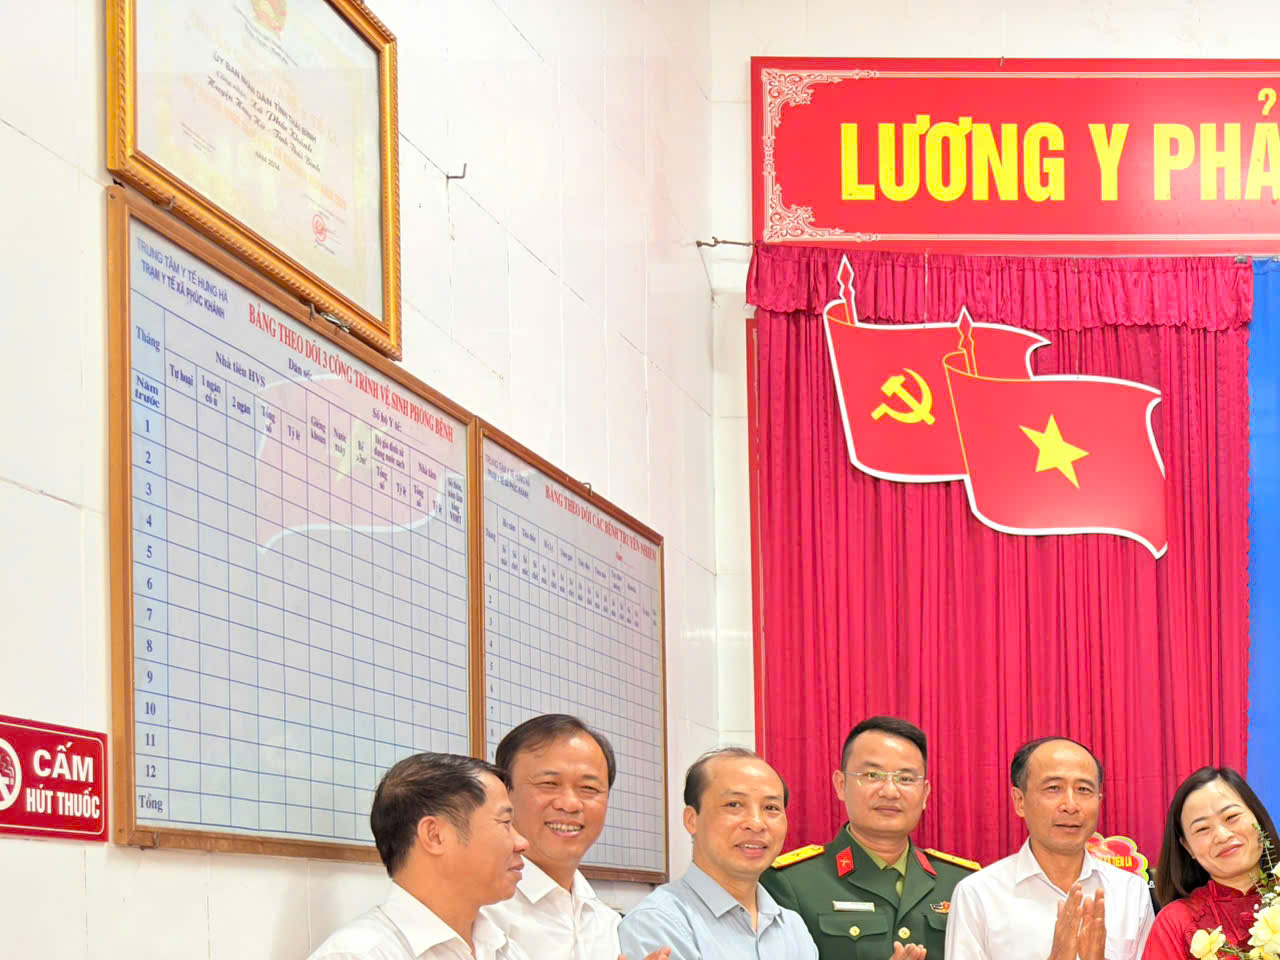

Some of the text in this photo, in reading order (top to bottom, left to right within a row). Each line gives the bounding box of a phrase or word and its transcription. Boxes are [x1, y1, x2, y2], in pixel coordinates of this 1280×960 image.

[841, 115, 1065, 201] LƯƠNG
[1088, 124, 1129, 200] Y
[136, 236, 163, 264] TRUNG
[165, 255, 180, 274] TÂM
[181, 265, 186, 278] Y
[187, 270, 197, 285] TẾ
[219, 288, 228, 303] HÀ
[161, 272, 166, 285] Y
[167, 275, 176, 291] TẾ
[186, 287, 203, 307] PHÚC
[136, 325, 160, 353] Tháng
[248, 368, 266, 388] HVS
[249, 302, 453, 443] BẢNG THEO DÕI 3 CÔNG TRÌNH VỆ SINH PHÒNG BỆNH
[136, 375, 159, 396] Năm
[135, 388, 160, 409] trước
[145, 419, 150, 433] 1
[145, 451, 152, 464] 2
[145, 482, 152, 496] 3
[146, 514, 153, 528] 4
[146, 545, 153, 559] 5
[146, 577, 153, 591] 6
[146, 608, 153, 622] 7
[146, 639, 153, 653] 8
[146, 670, 153, 685] 9
[145, 701, 156, 716] 10
[145, 733, 156, 747] 11
[33, 741, 94, 783] CẤM
[146, 764, 157, 779] 12
[26, 783, 100, 819] HÚT THUỐC
[138, 792, 164, 813] Tổng
